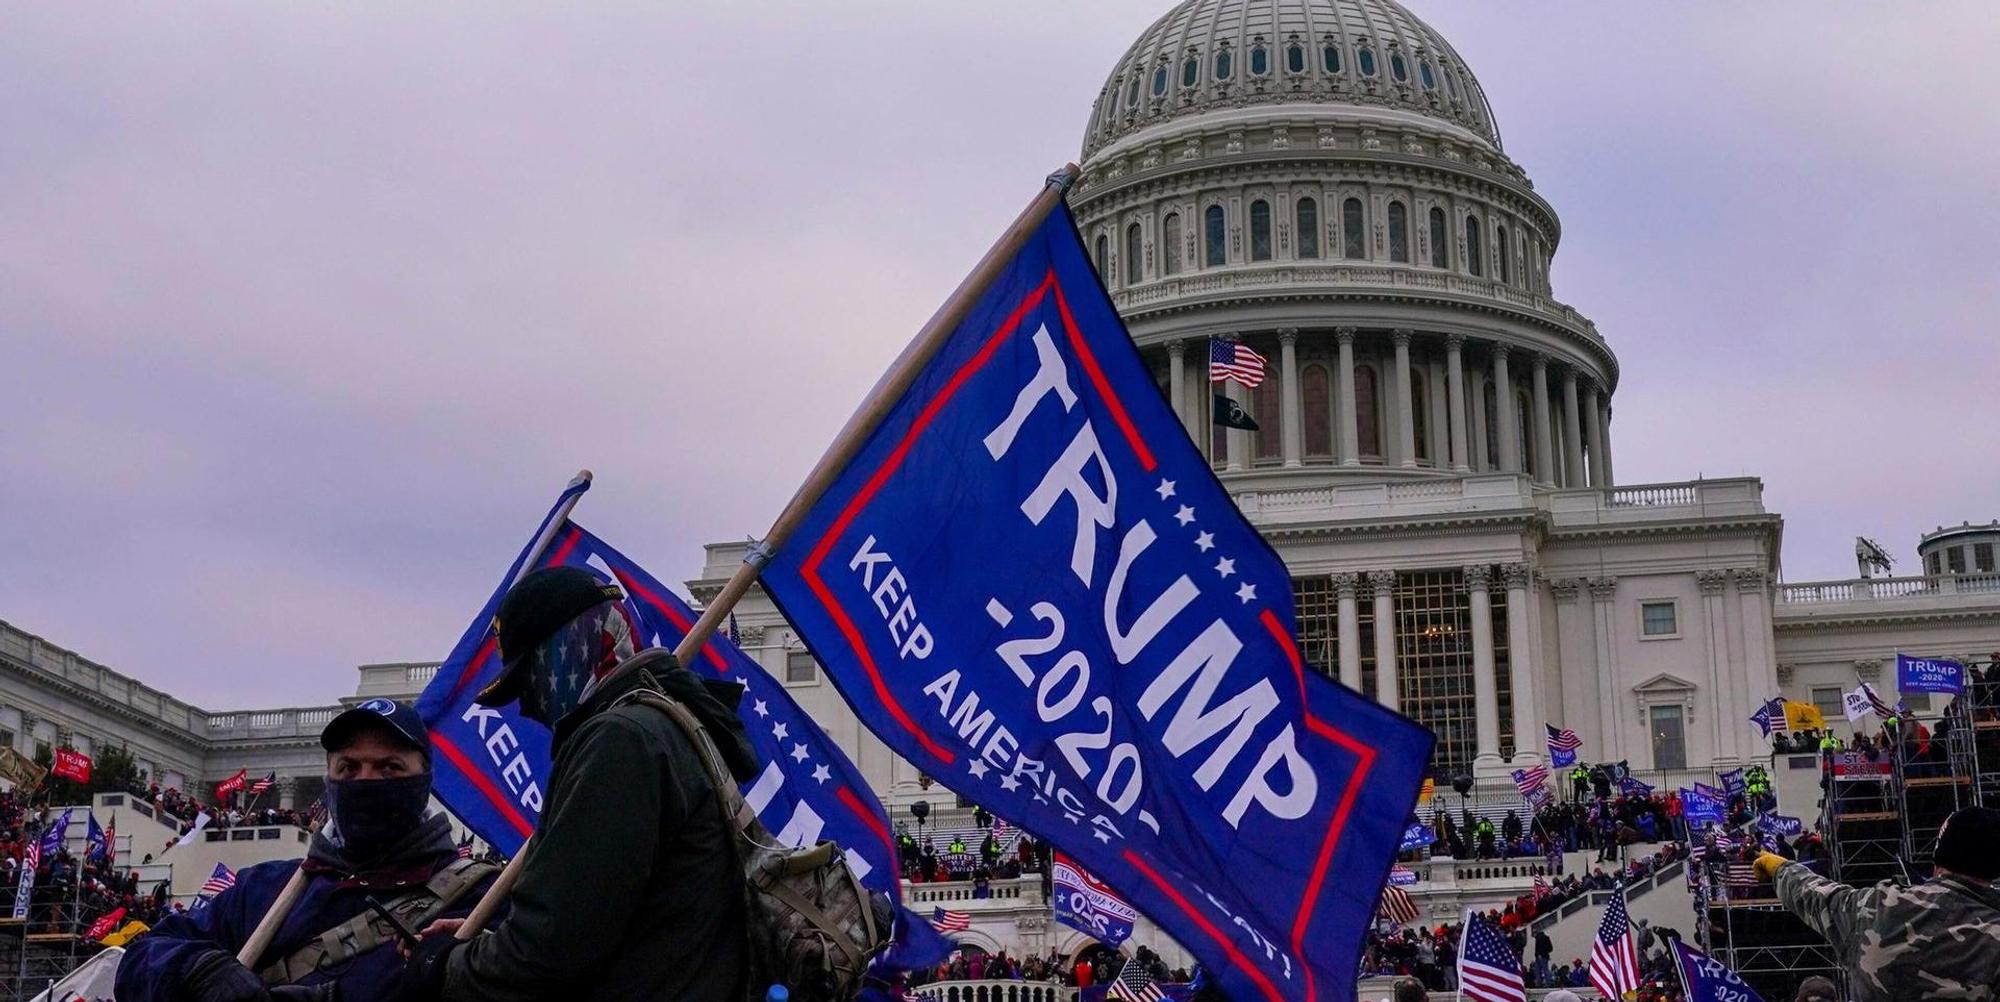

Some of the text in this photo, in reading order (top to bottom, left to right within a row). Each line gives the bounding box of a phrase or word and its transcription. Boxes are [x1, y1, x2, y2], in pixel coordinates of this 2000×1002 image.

[849, 534, 934, 661] KEEP
[922, 668, 1126, 840] AMERICA
[983, 323, 1318, 831] TRUMP
[1906, 660, 1957, 677] TRUMP
[461, 702, 544, 814] KEEP
[985, 597, 1161, 836] -2020-
